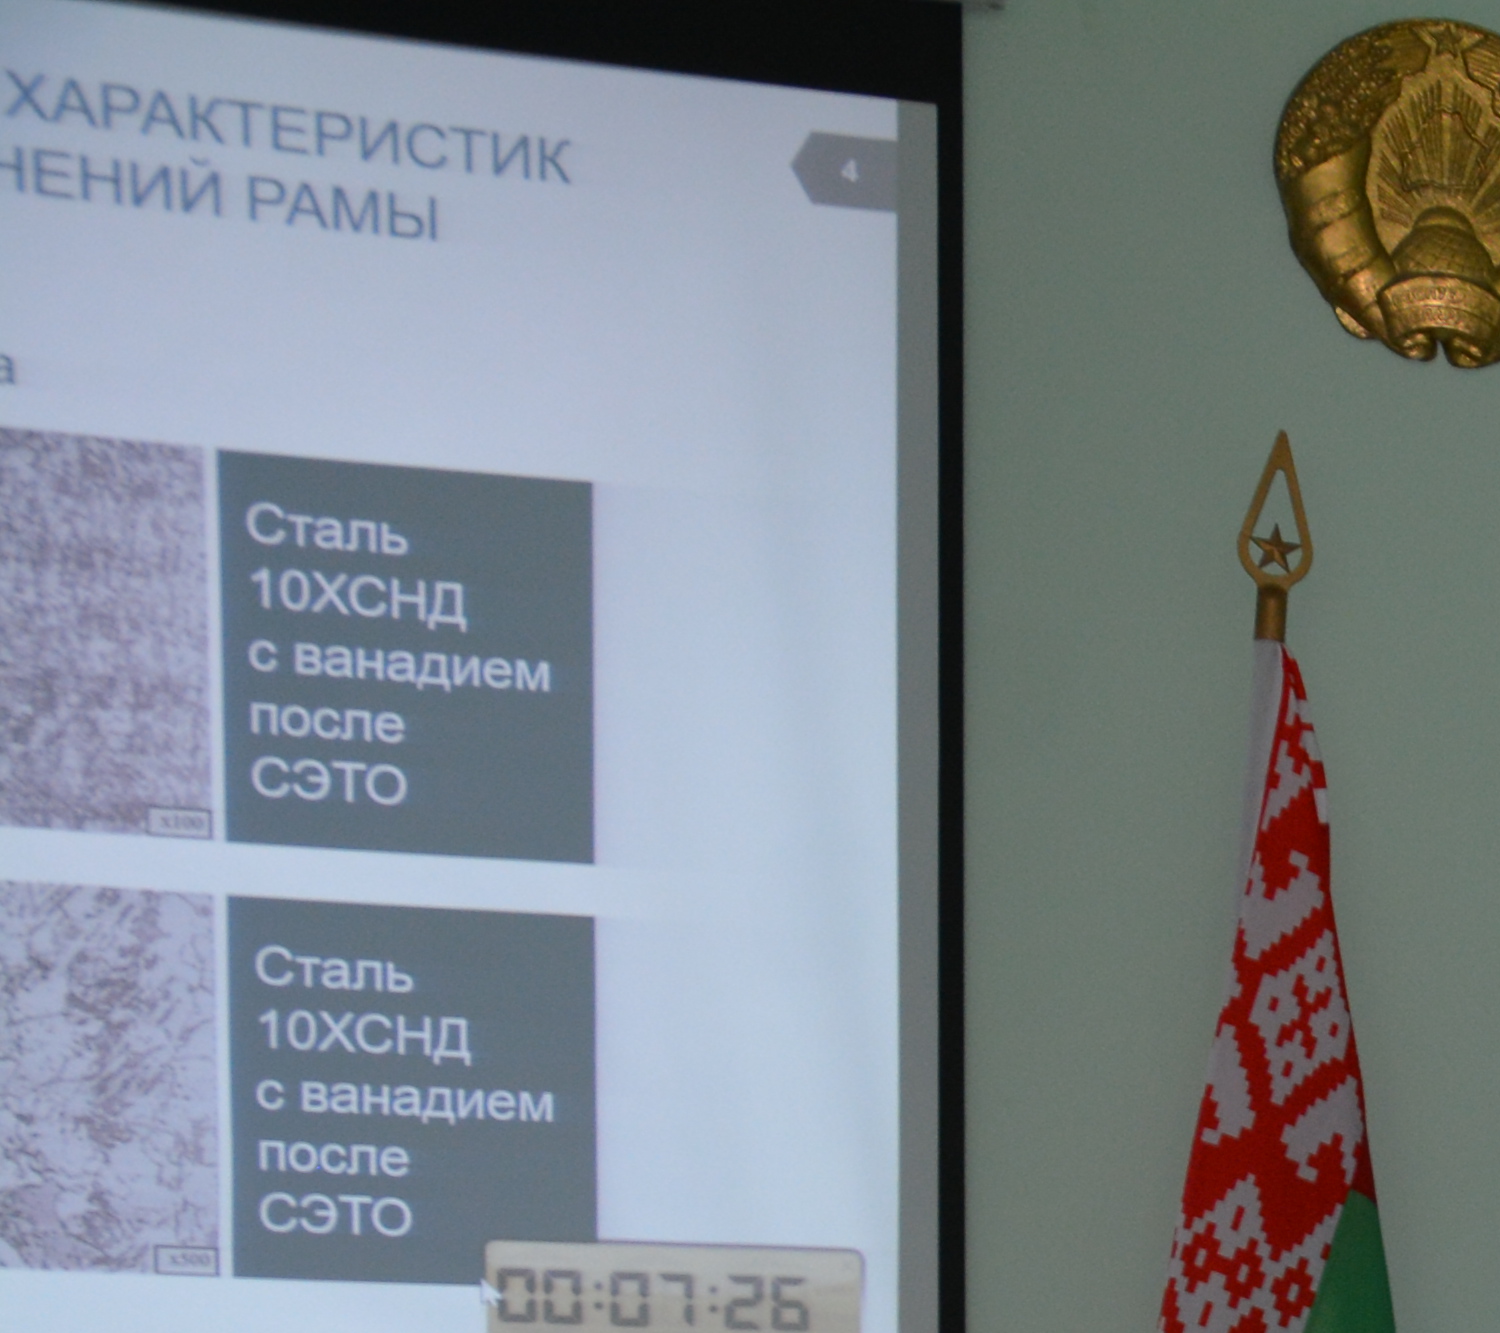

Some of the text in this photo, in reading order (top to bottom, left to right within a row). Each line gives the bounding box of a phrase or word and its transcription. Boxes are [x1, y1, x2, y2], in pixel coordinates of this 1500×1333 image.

[3, 68, 574, 187] ХАРАКТЕРИСТИК
[839, 158, 859, 184] 4
[247, 176, 440, 242] РАМЫ
[244, 502, 409, 558] Сталь
[250, 567, 468, 632] 10ХСНД
[247, 640, 552, 694] с ванадием
[249, 702, 406, 744] после
[251, 754, 409, 807] СЭТО
[254, 946, 415, 995] Сталь
[258, 1008, 473, 1066] 10ХСНД
[256, 1080, 555, 1123] с ванадием
[258, 1138, 411, 1177] после
[258, 1191, 413, 1238] СЭТО
[496, 1266, 812, 1333] 00:07:26
